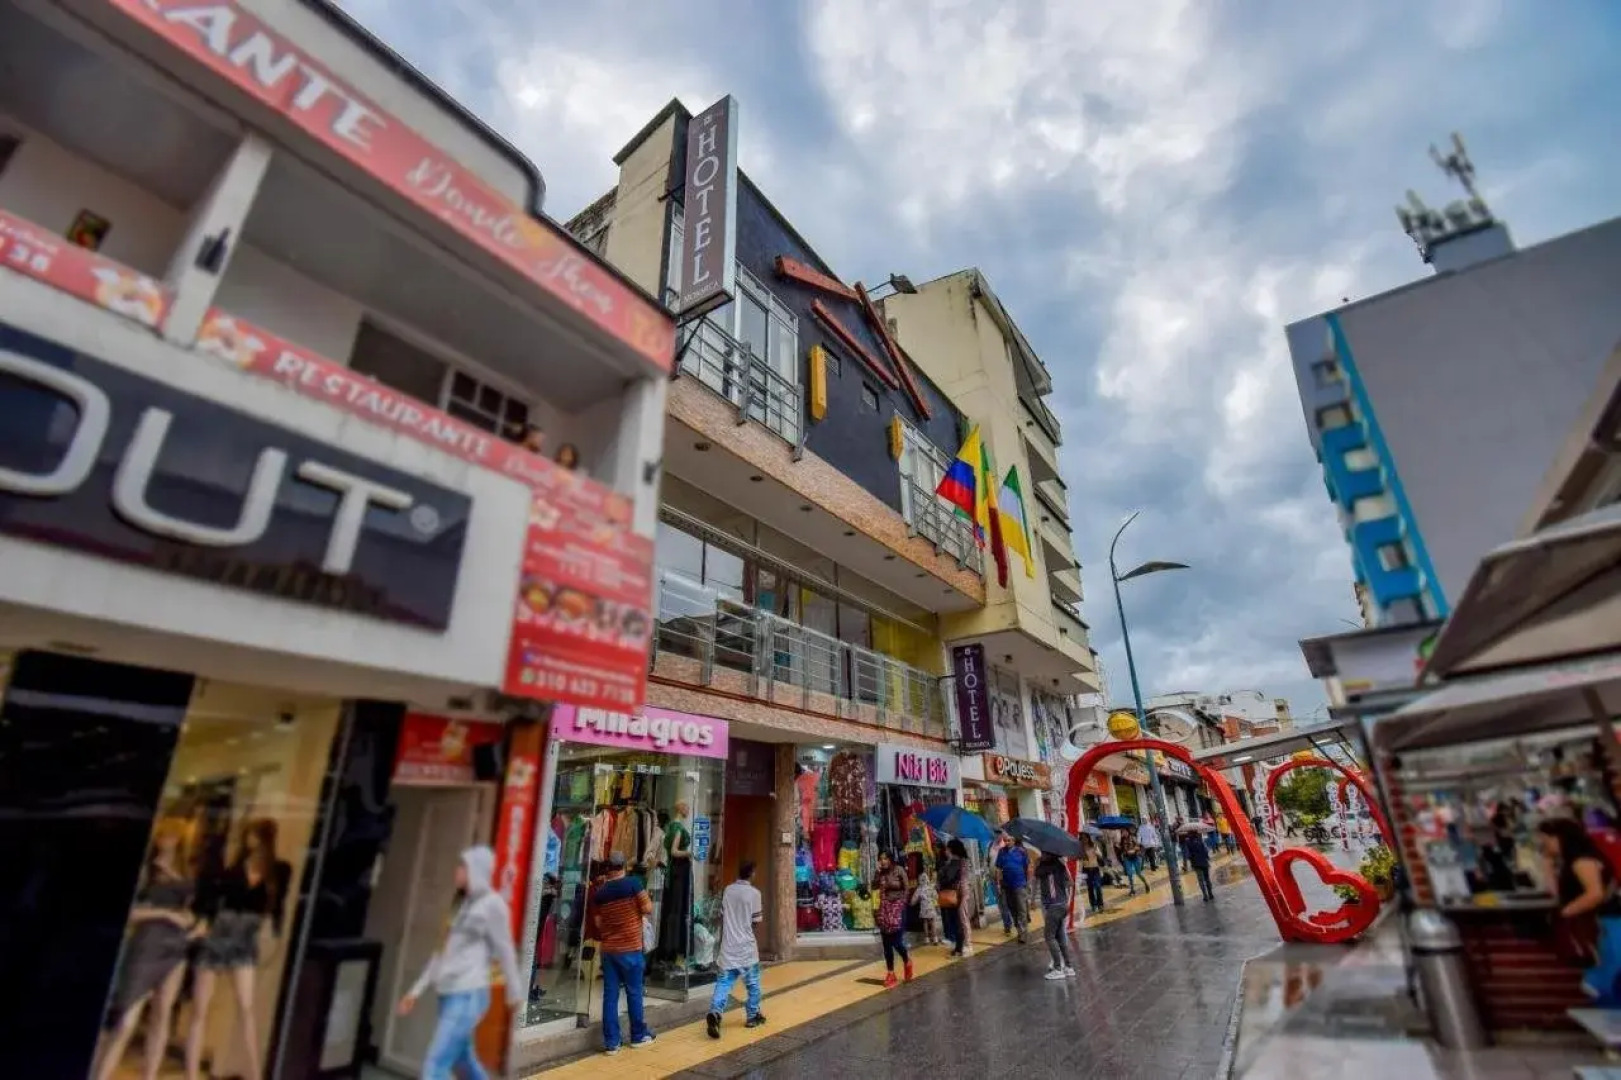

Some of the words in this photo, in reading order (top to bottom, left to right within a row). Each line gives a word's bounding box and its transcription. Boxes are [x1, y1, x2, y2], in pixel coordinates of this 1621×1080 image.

[149, 0, 387, 152] ANTE
[693, 124, 719, 286] HOTEL
[272, 350, 492, 458] RESTAURANTE
[964, 656, 981, 739] HOTEL
